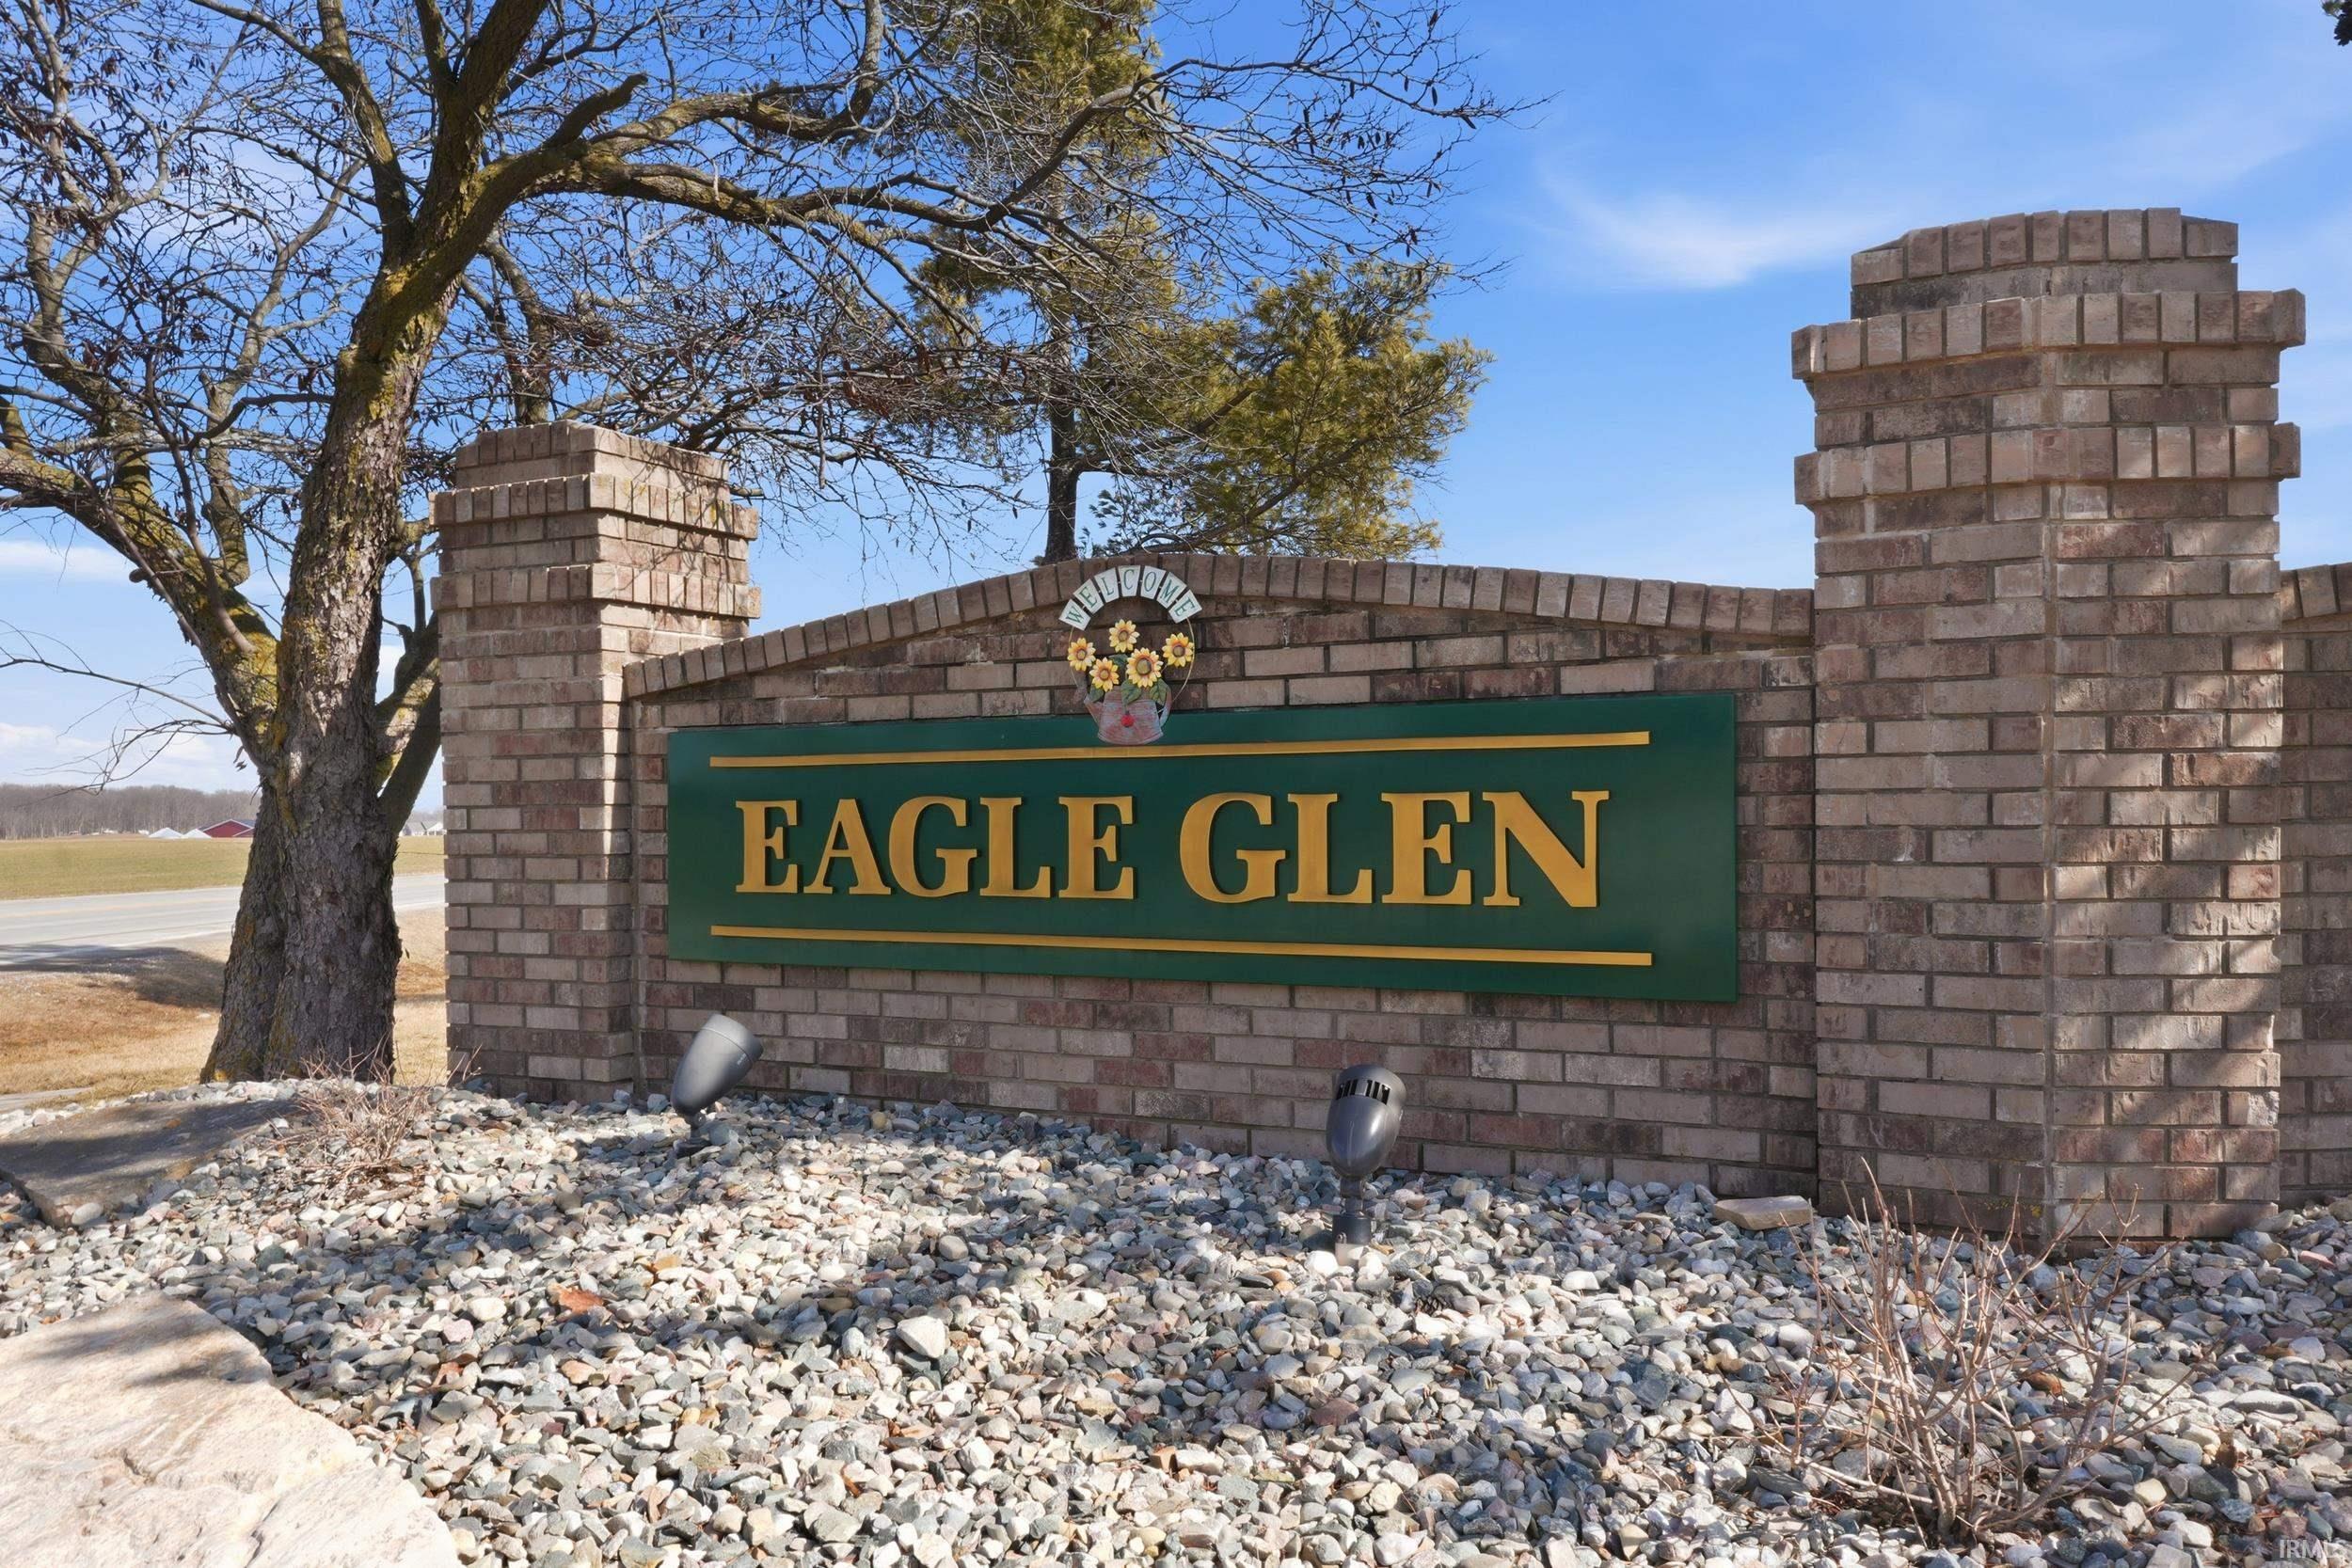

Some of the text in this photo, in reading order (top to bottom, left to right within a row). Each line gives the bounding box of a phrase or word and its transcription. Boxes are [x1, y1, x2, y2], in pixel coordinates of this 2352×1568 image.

[1064, 567, 1198, 625] WELCOME
[736, 790, 1610, 908] EAGLE GLEN
